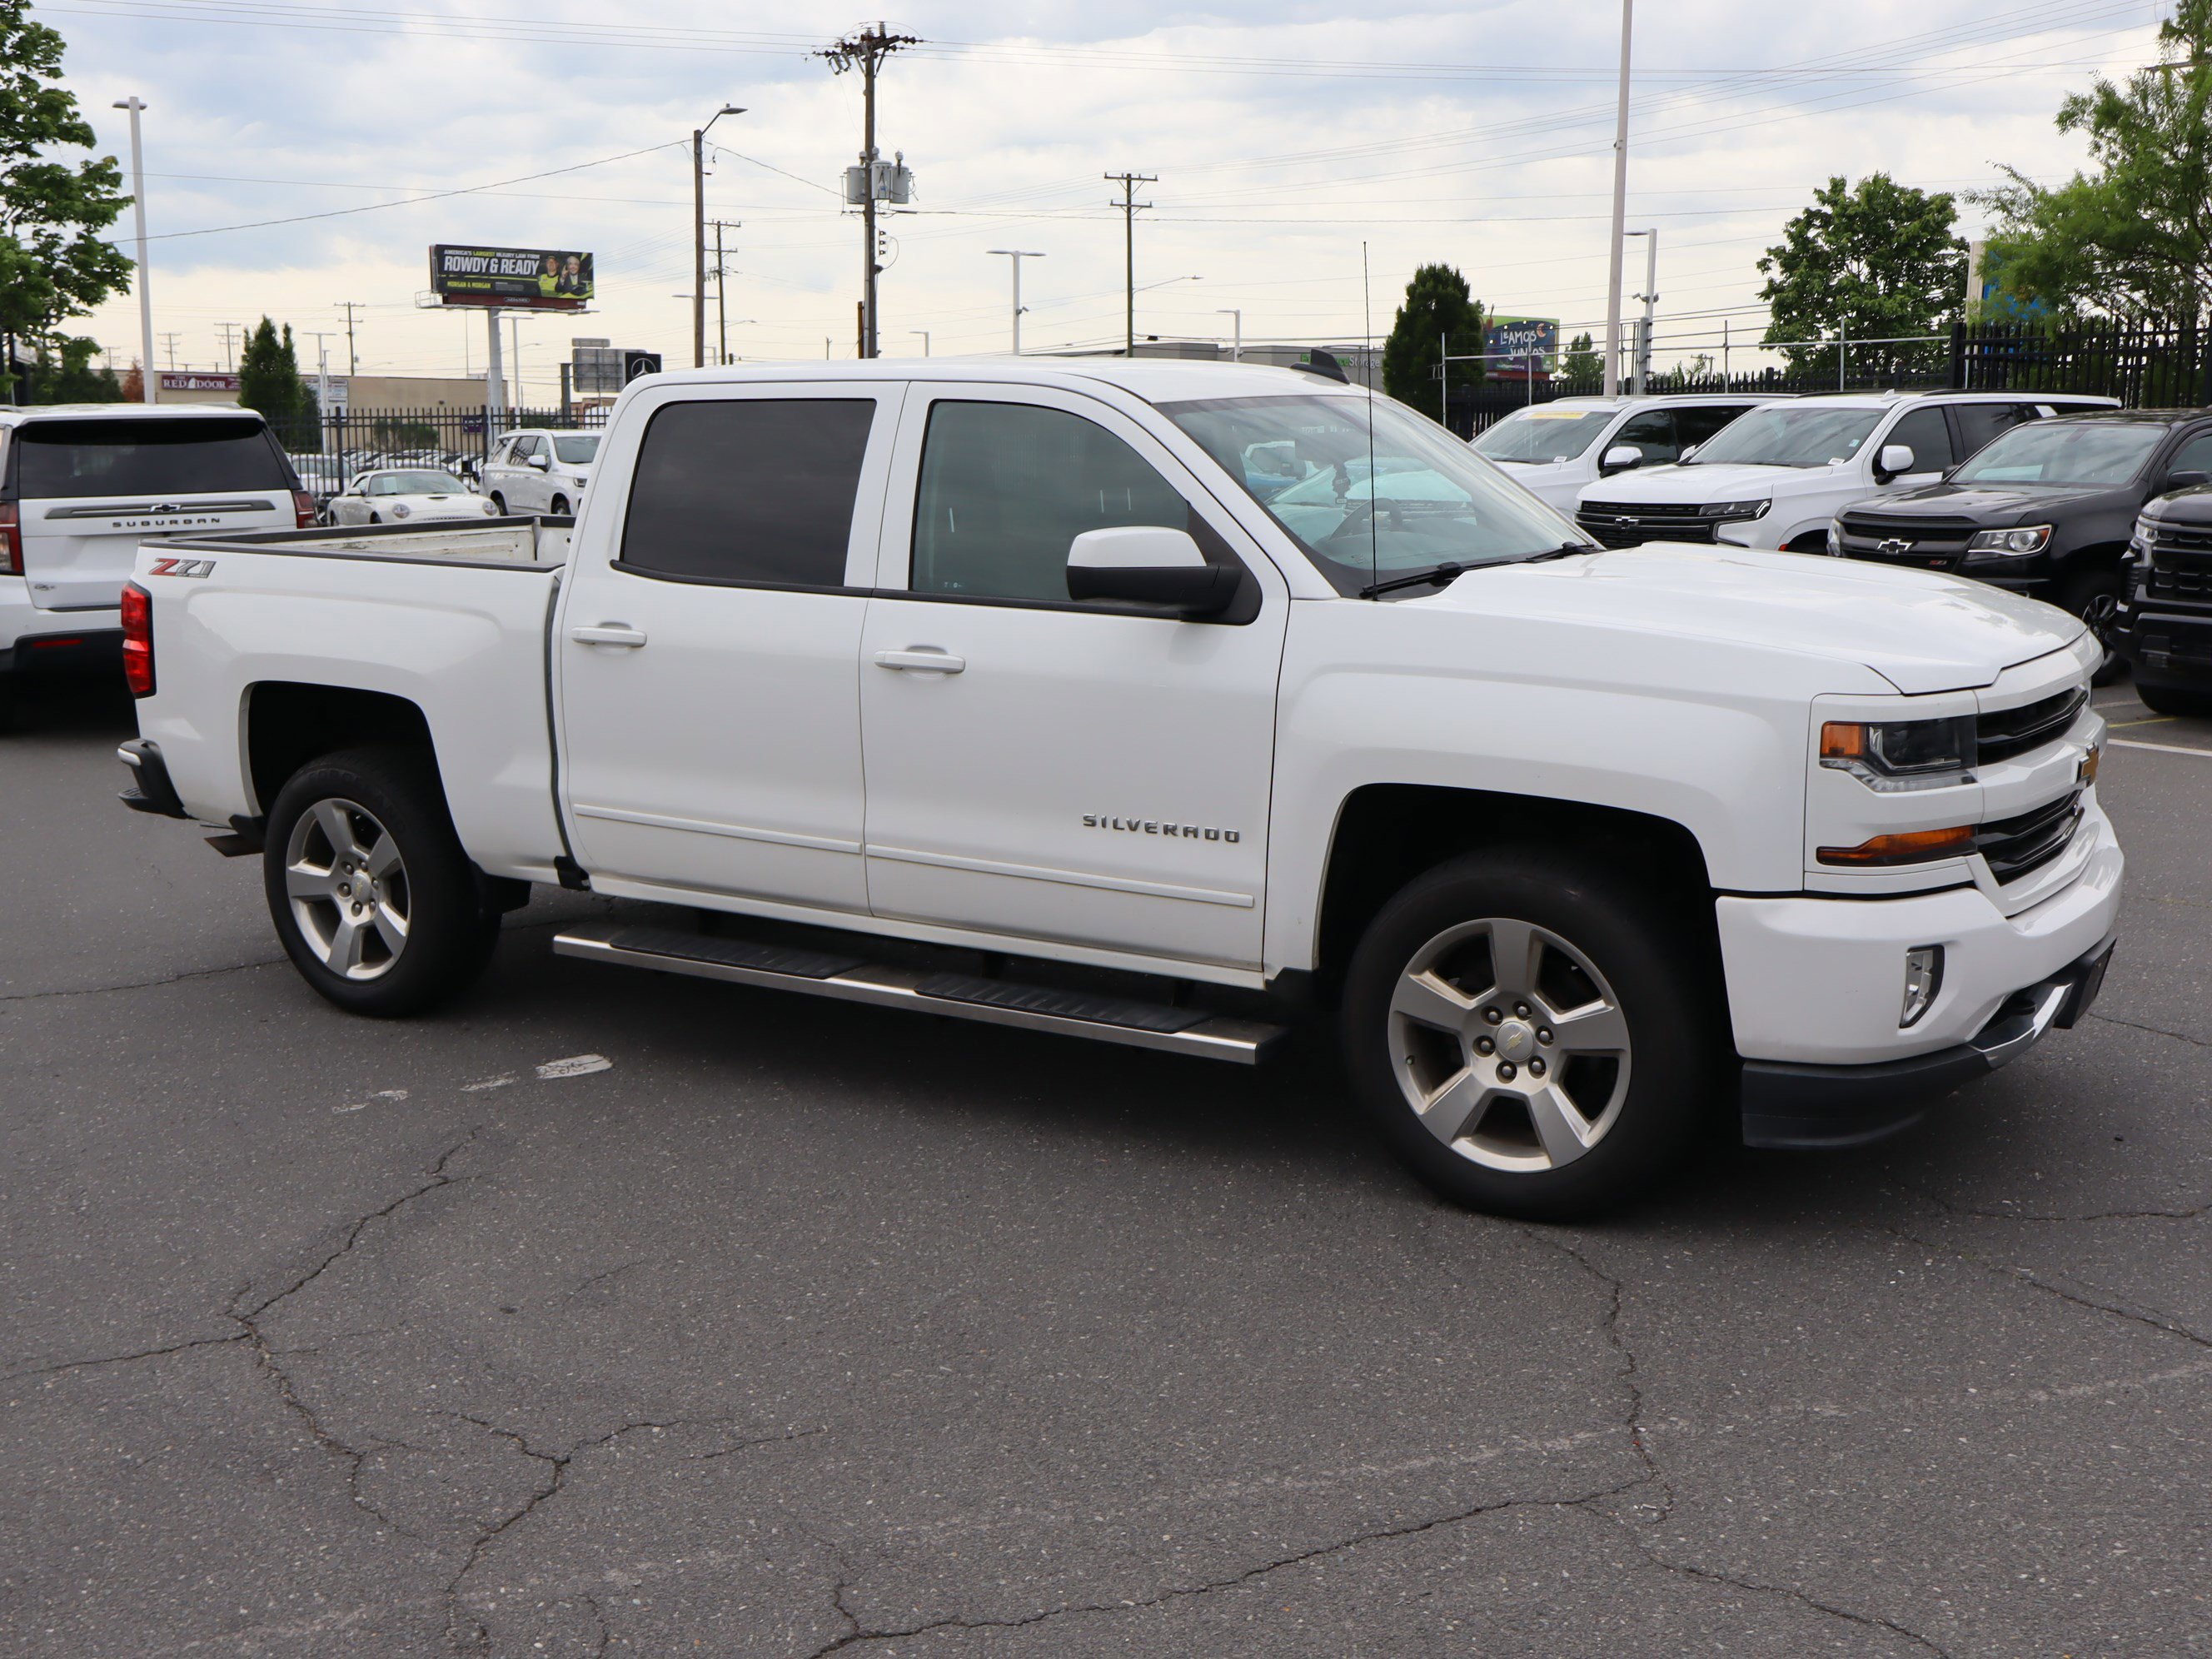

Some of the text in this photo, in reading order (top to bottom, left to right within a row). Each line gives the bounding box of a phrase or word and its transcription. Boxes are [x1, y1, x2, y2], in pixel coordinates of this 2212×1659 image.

[444, 256, 541, 276] ROWDY & READY
[1508, 346, 1546, 361] JUNOS
[1349, 356, 1380, 369] Storage
[163, 379, 187, 388] RED
[197, 380, 227, 389] DOOR
[112, 518, 220, 528] SUBURBAN
[148, 557, 217, 578] Z71
[1083, 813, 1240, 843] SILVERADO
